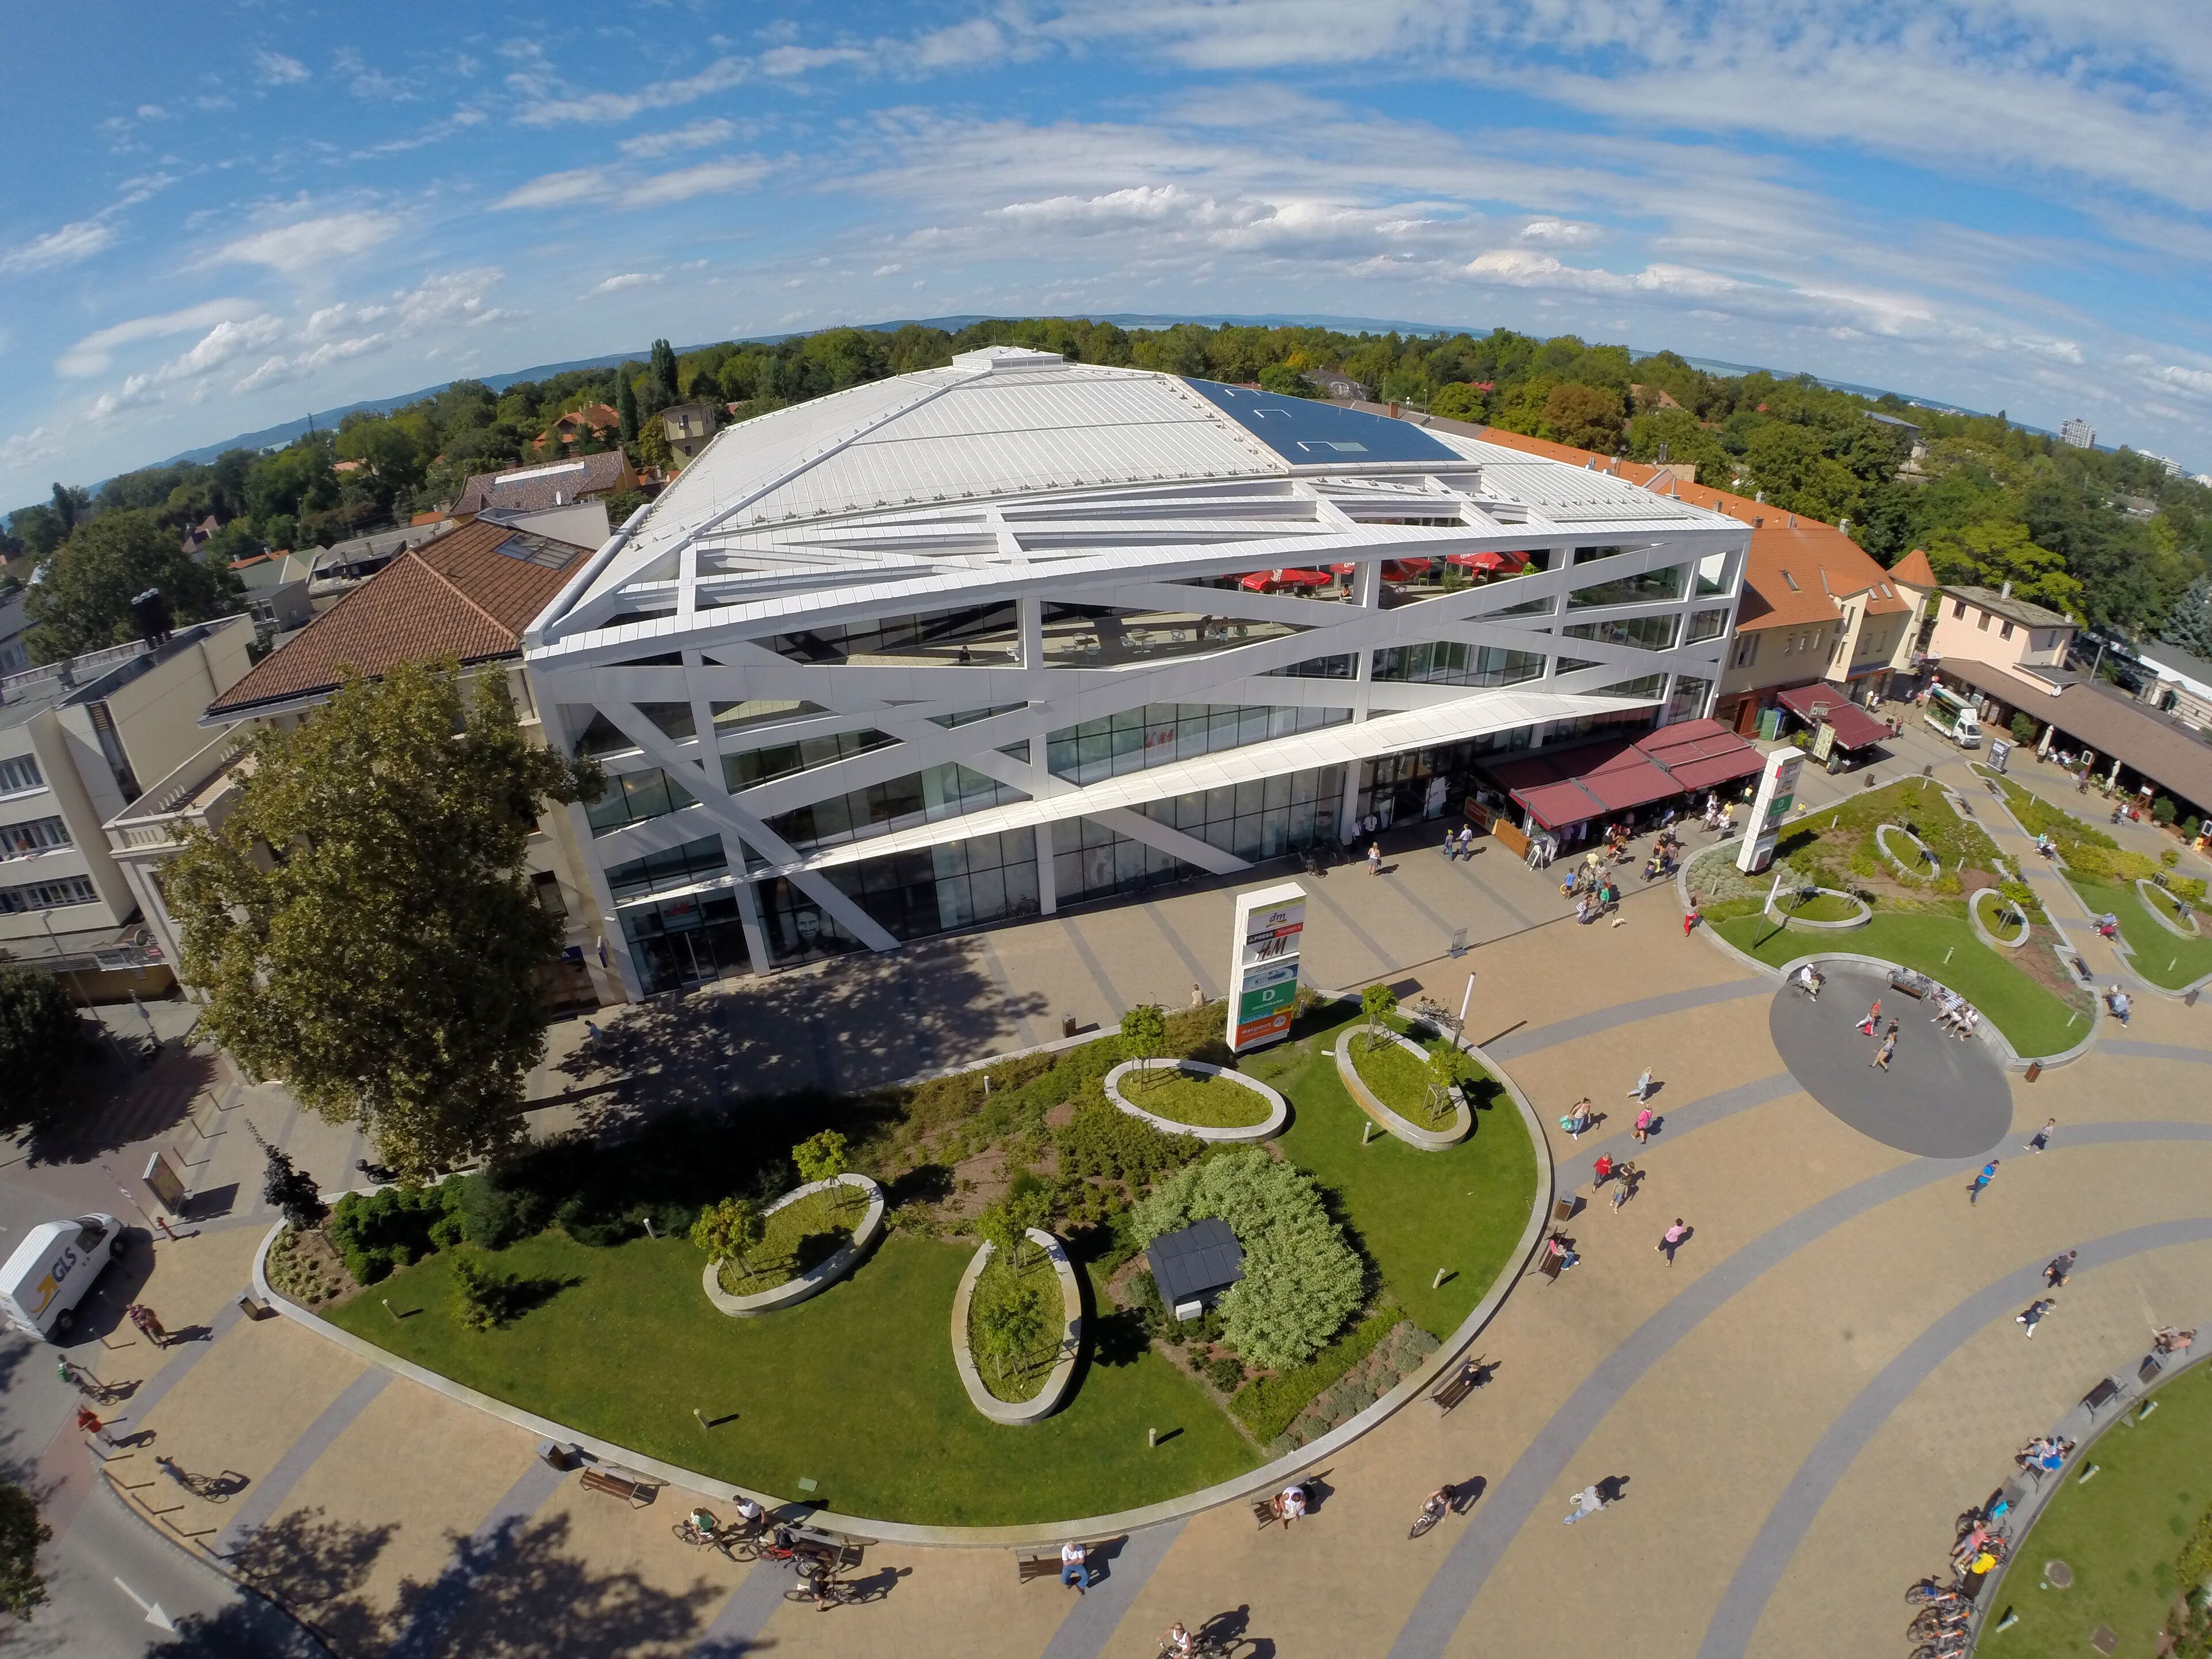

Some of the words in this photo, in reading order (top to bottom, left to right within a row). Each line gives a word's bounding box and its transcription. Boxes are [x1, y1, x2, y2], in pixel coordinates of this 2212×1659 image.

[1778, 799, 1785, 808] D
[1269, 912, 1286, 923] dm
[1248, 931, 1273, 942] J.PRESS
[1277, 926, 1297, 934] Triumph
[1262, 988, 1276, 1002] D
[1241, 1022, 1271, 1035] expert
[52, 1247, 77, 1282] GLS
